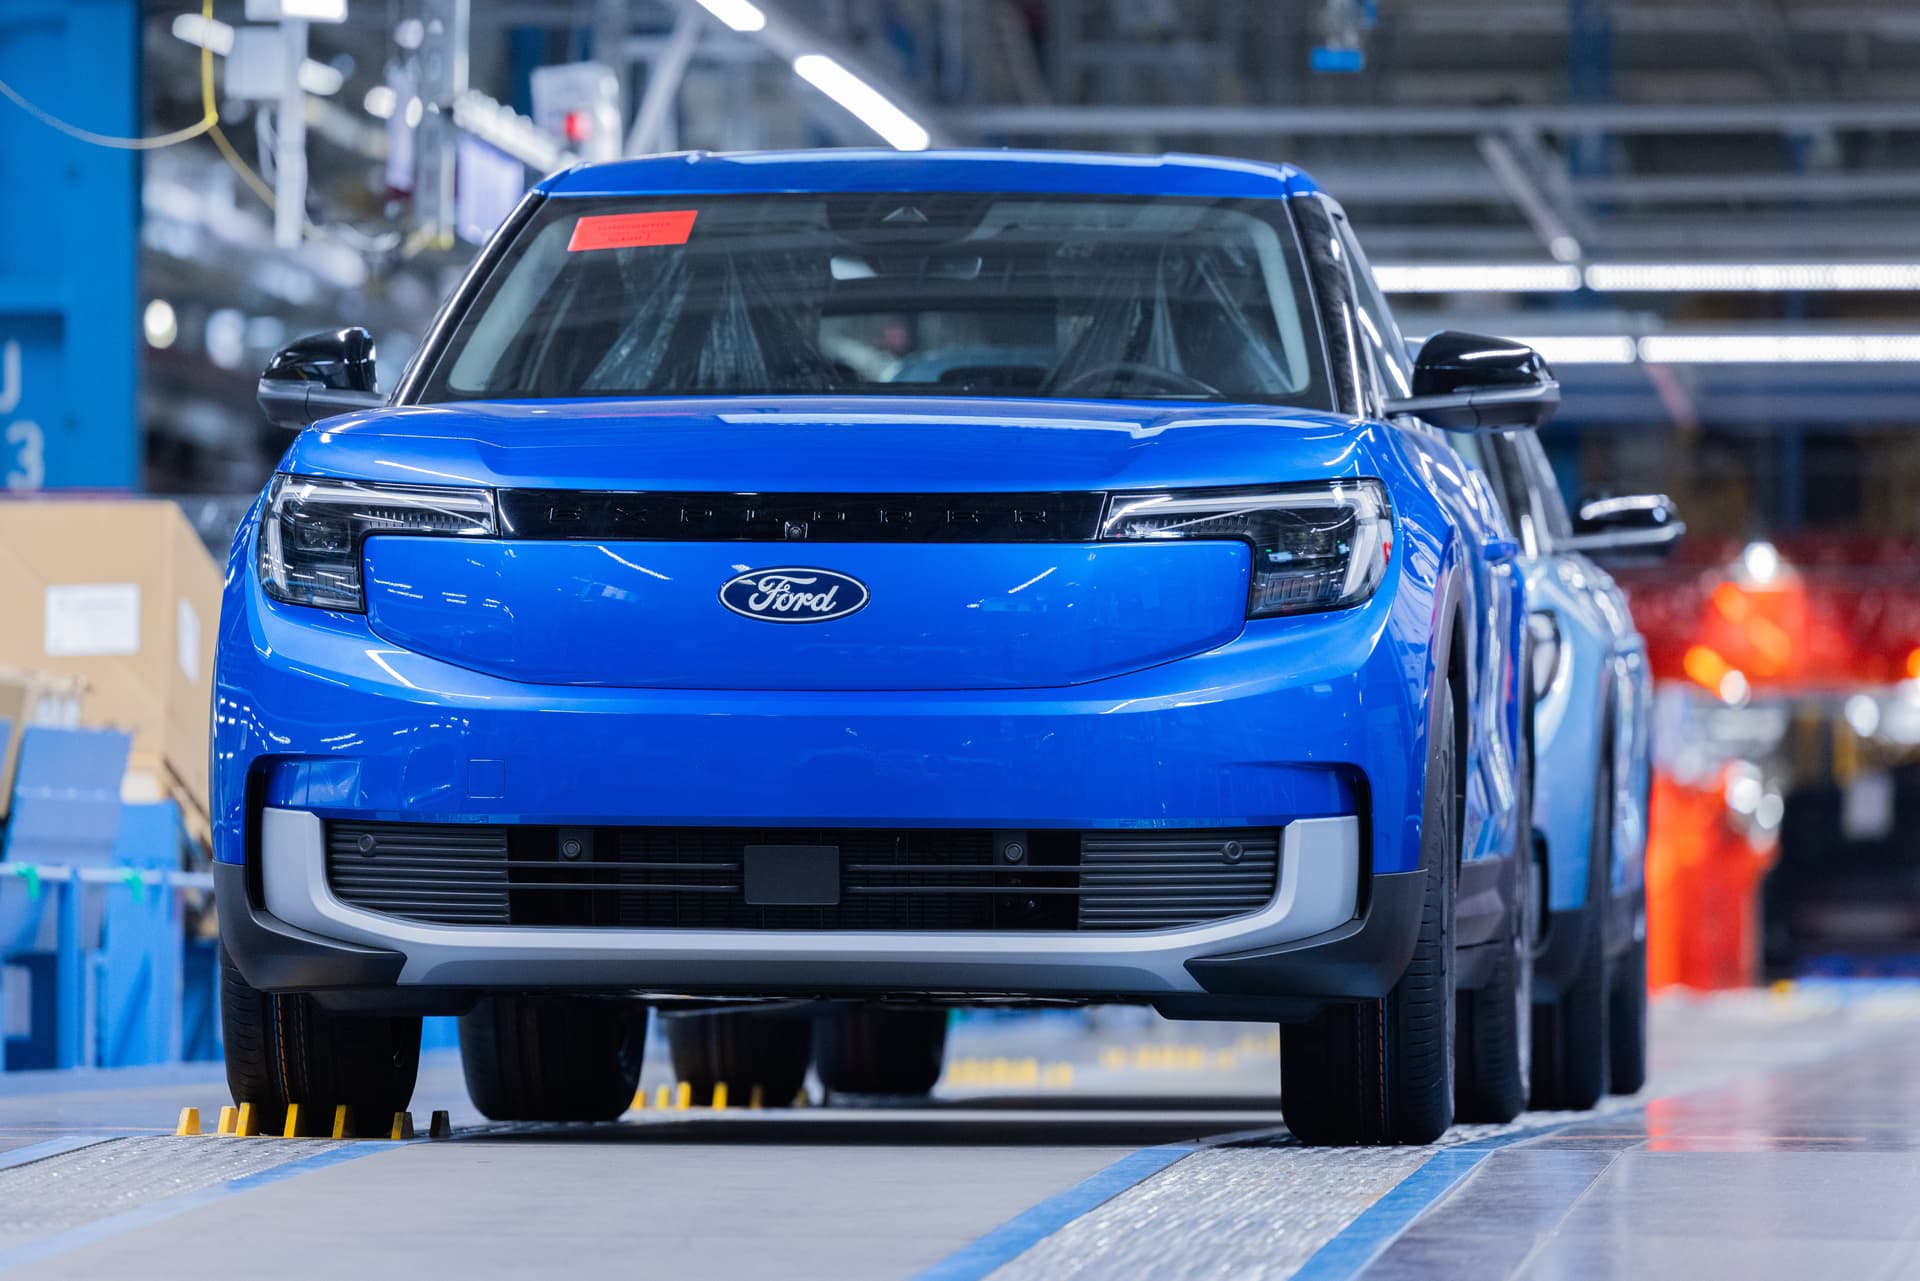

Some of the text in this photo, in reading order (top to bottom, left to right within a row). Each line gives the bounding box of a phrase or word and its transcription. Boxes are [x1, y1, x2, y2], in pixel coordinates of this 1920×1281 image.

[6, 420, 45, 491] 3
[548, 506, 1048, 524] EXPLORER
[748, 575, 840, 612] Ford
